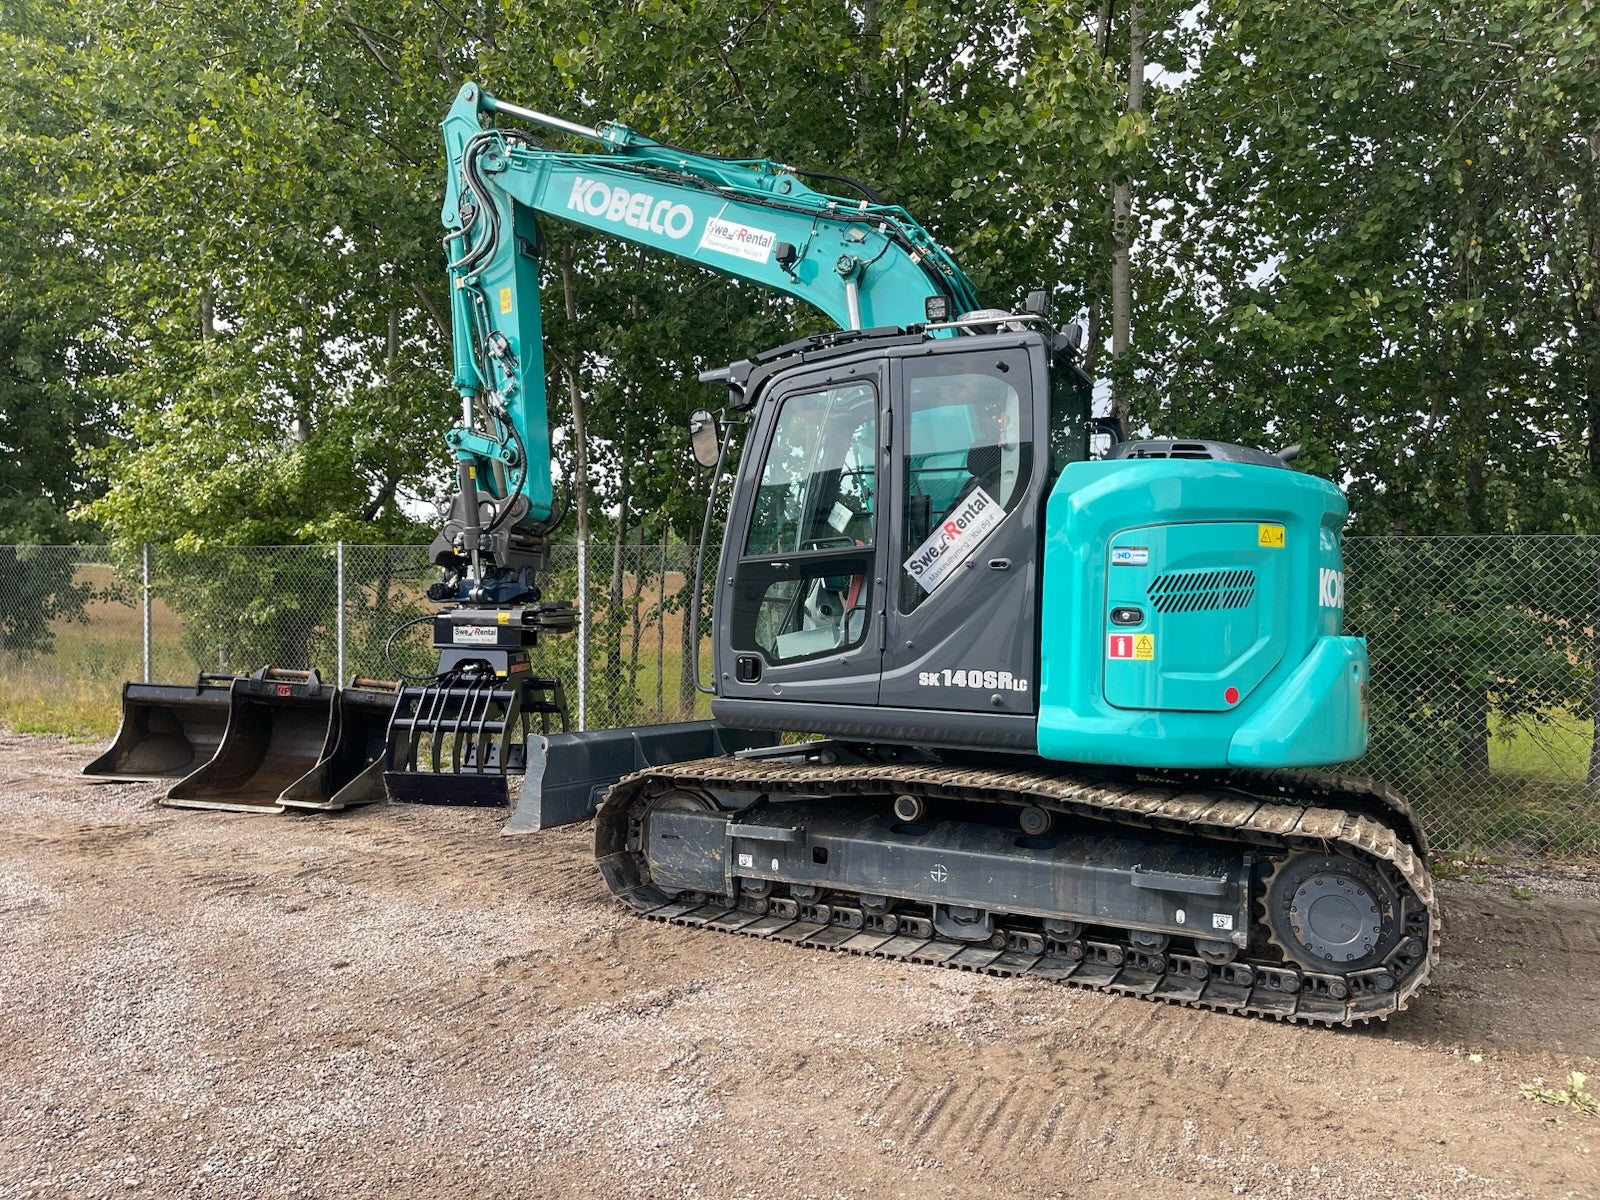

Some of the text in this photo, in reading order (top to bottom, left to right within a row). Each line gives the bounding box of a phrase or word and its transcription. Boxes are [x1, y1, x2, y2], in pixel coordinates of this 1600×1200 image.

[567, 176, 694, 239] KOBELCO
[737, 228, 773, 248] Rental
[909, 493, 989, 576] Swe Rental
[454, 627, 497, 637] Swe Rental
